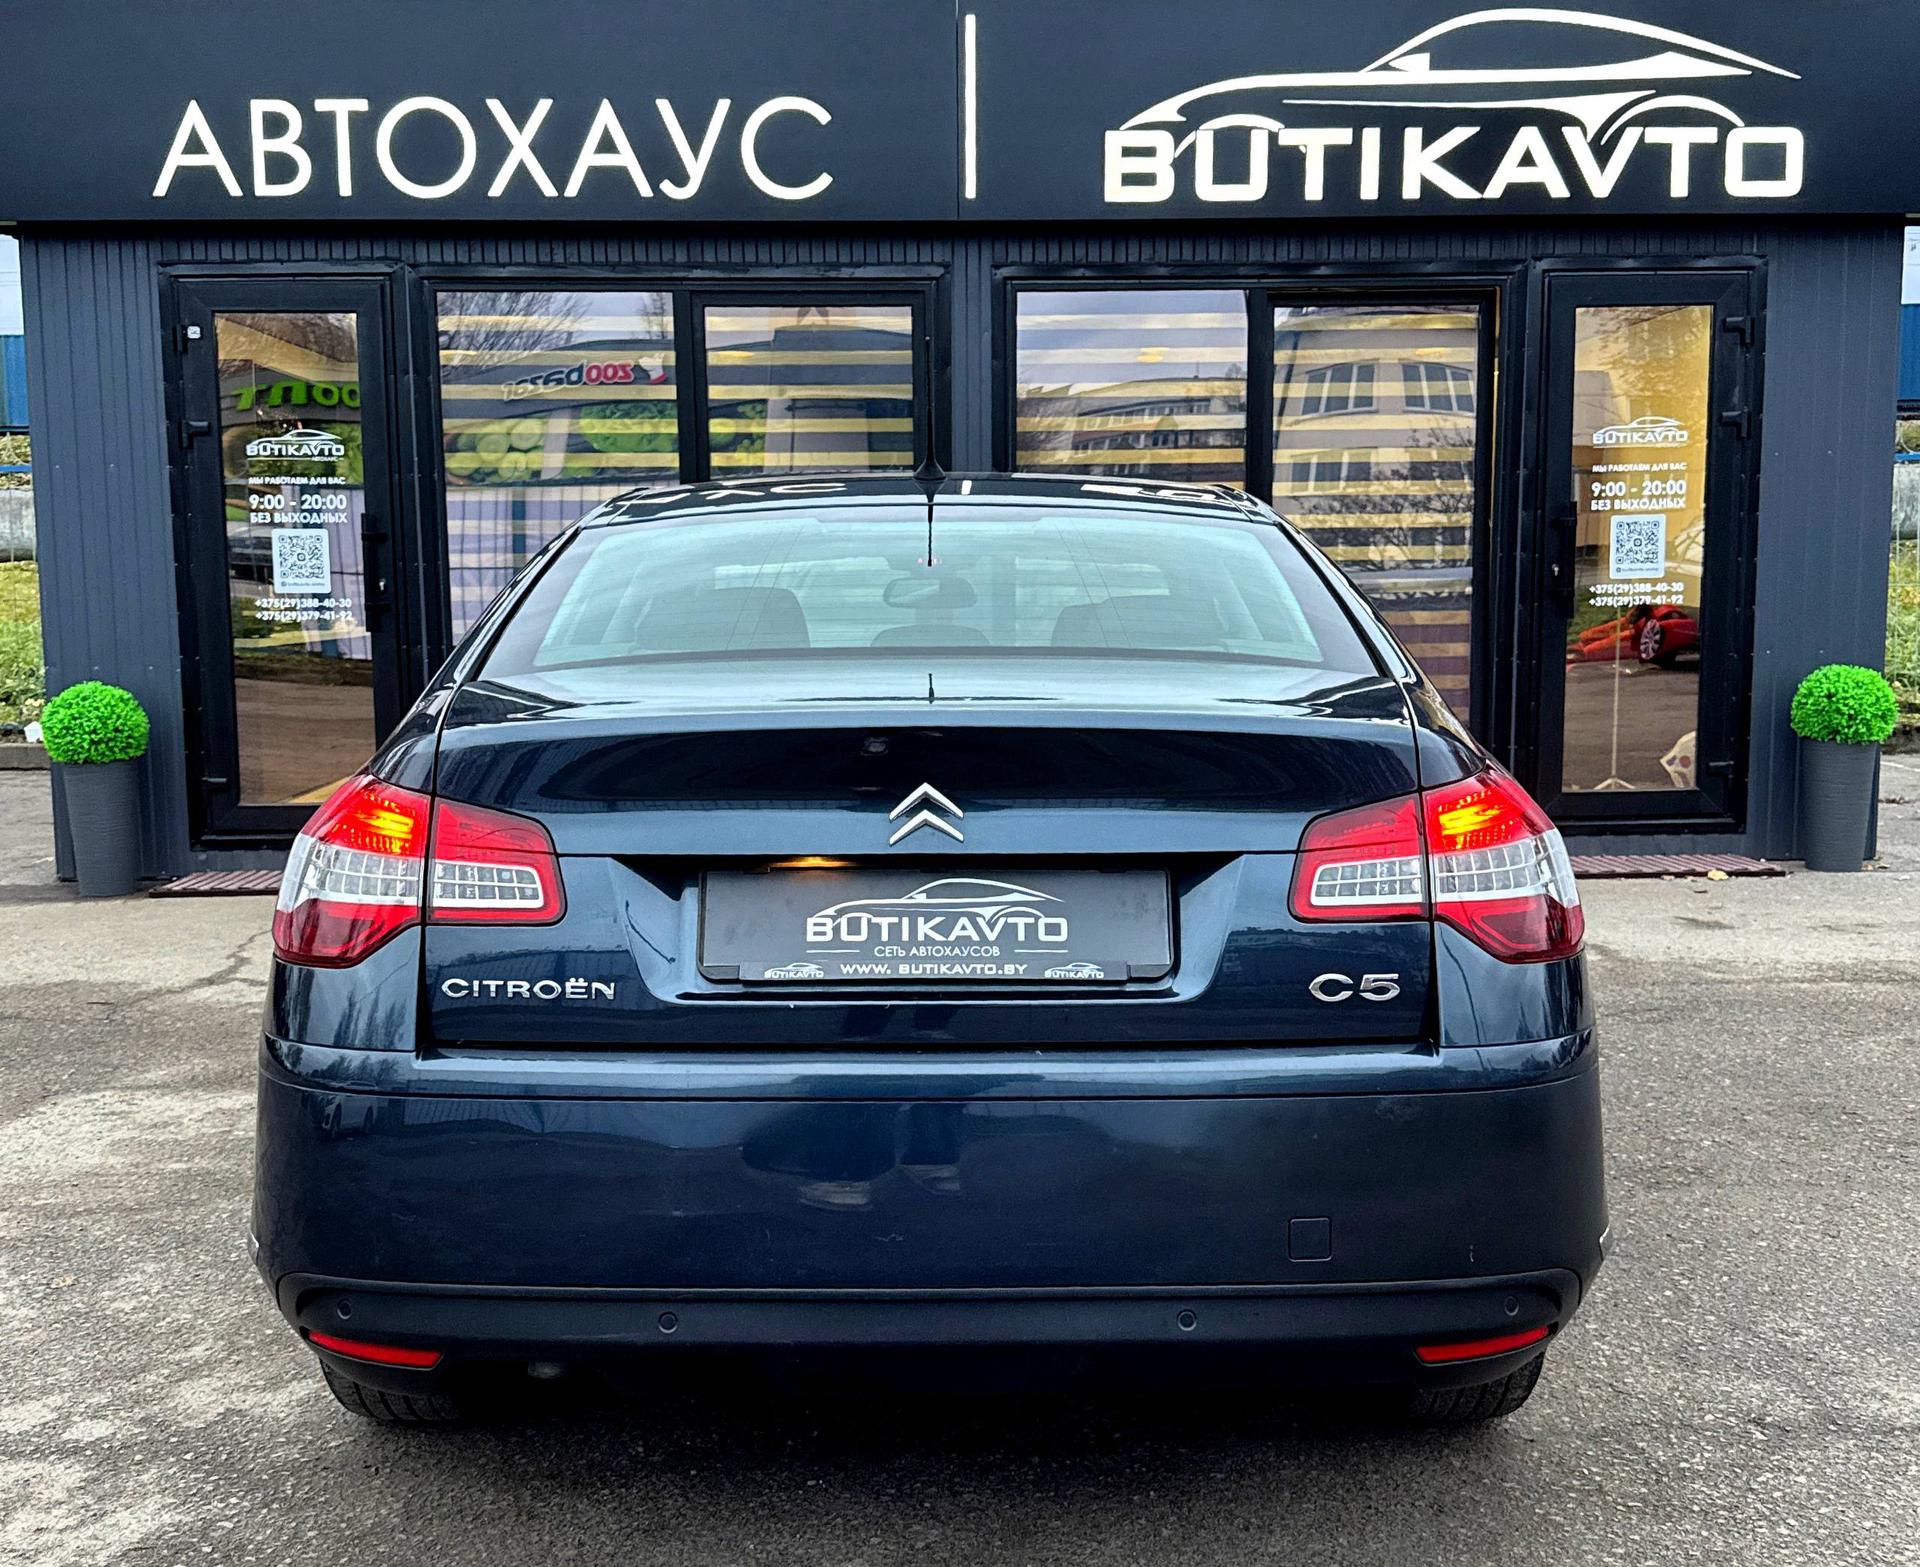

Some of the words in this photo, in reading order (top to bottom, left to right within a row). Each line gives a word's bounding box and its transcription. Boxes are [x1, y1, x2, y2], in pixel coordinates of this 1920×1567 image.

[152, 95, 834, 200] АВТОХАУС
[1104, 126, 1804, 203] BUTIKAVTO
[1593, 431, 1688, 444] BUTIKAVTO
[246, 444, 345, 456] BUTIKAVTO
[1608, 464, 1650, 472] РАБОТАЕМ
[1670, 462, 1687, 470] ВАС
[1591, 481, 1626, 497] 9:00
[1642, 480, 1686, 496] 20:00
[249, 494, 284, 510] 9:00
[301, 494, 347, 510] 20:00
[1591, 499, 1611, 510] БЕЗ
[1614, 498, 1685, 510] ВЫХОДНЫХ
[250, 512, 271, 523] БЕЗ
[274, 512, 348, 524] ВЫХОДНЫХ
[805, 916, 1068, 942] BUTIKAVTO
[874, 946, 906, 957] СЕТЬ
[909, 946, 1000, 957] АВТОХАУСОВ
[840, 963, 891, 975] WWW.
[899, 963, 1028, 975] BUTIKAVTO.BY
[441, 977, 615, 1000] CITROËN
[1308, 973, 1400, 1002] C5
